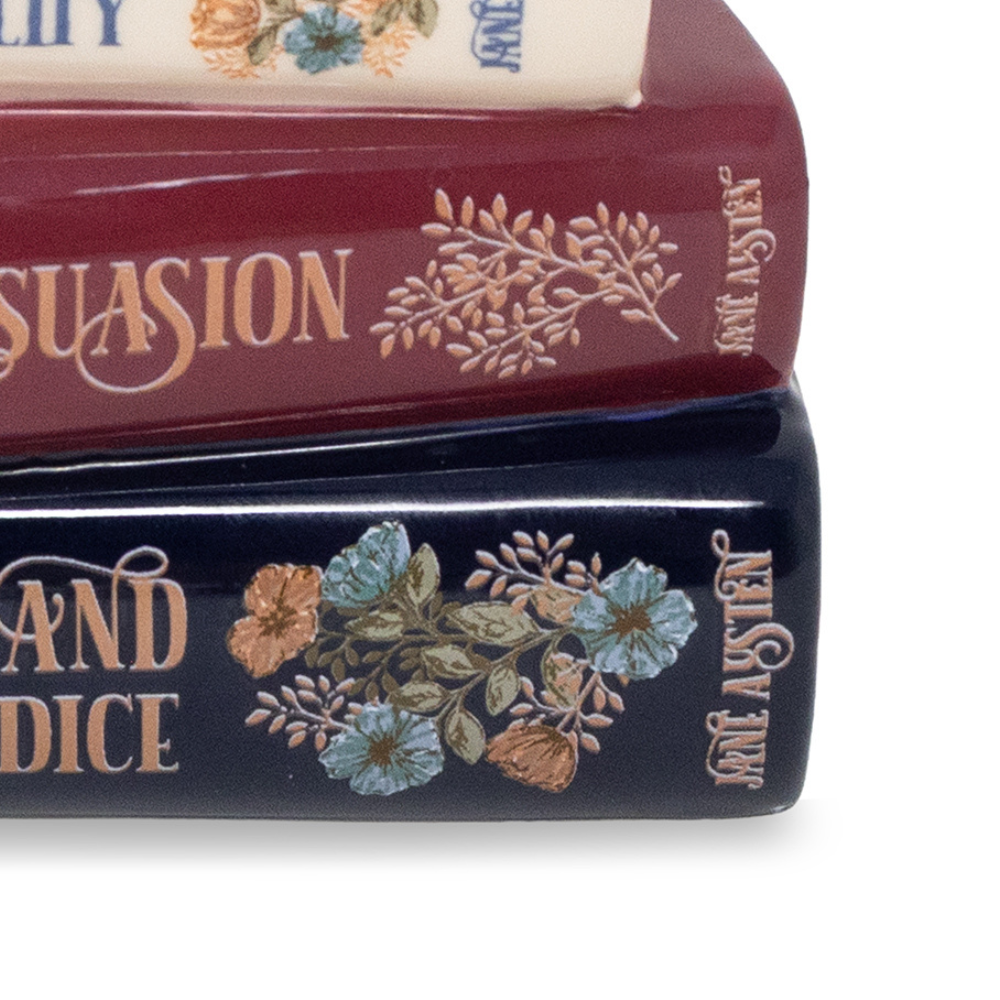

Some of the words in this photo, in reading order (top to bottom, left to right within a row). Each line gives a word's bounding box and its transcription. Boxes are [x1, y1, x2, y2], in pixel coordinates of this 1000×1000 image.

[713, 292, 759, 357] JANE
[711, 529, 795, 700] AUSTEN
[706, 709, 769, 790] JANE
